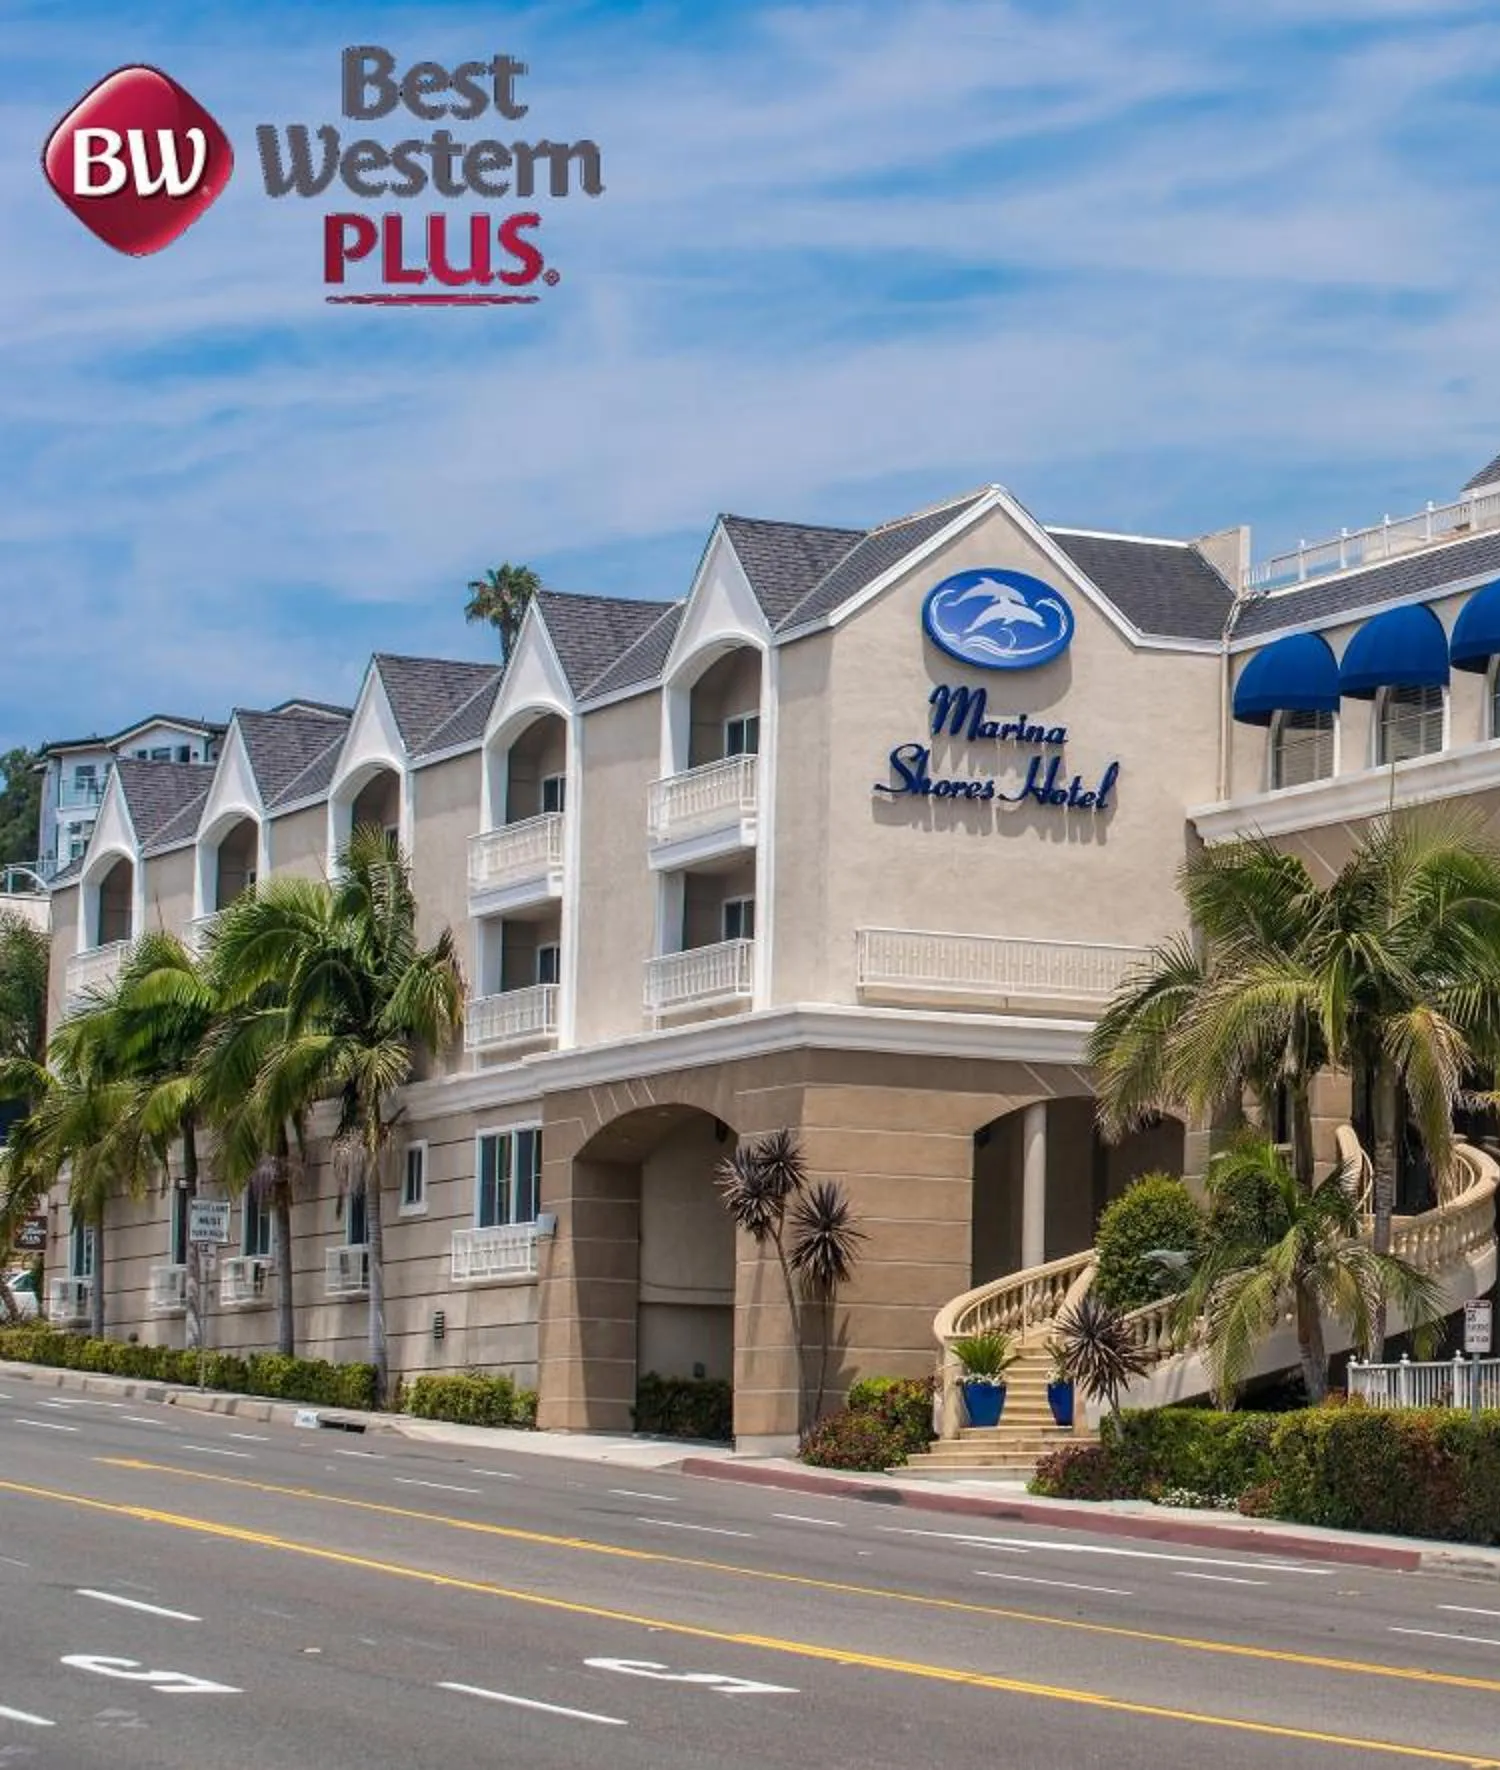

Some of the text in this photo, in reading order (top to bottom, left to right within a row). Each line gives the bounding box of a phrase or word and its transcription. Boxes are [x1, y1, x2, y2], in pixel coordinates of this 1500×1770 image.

[928, 684, 1067, 745] Marina
[874, 743, 1119, 810] Shores Hotel
